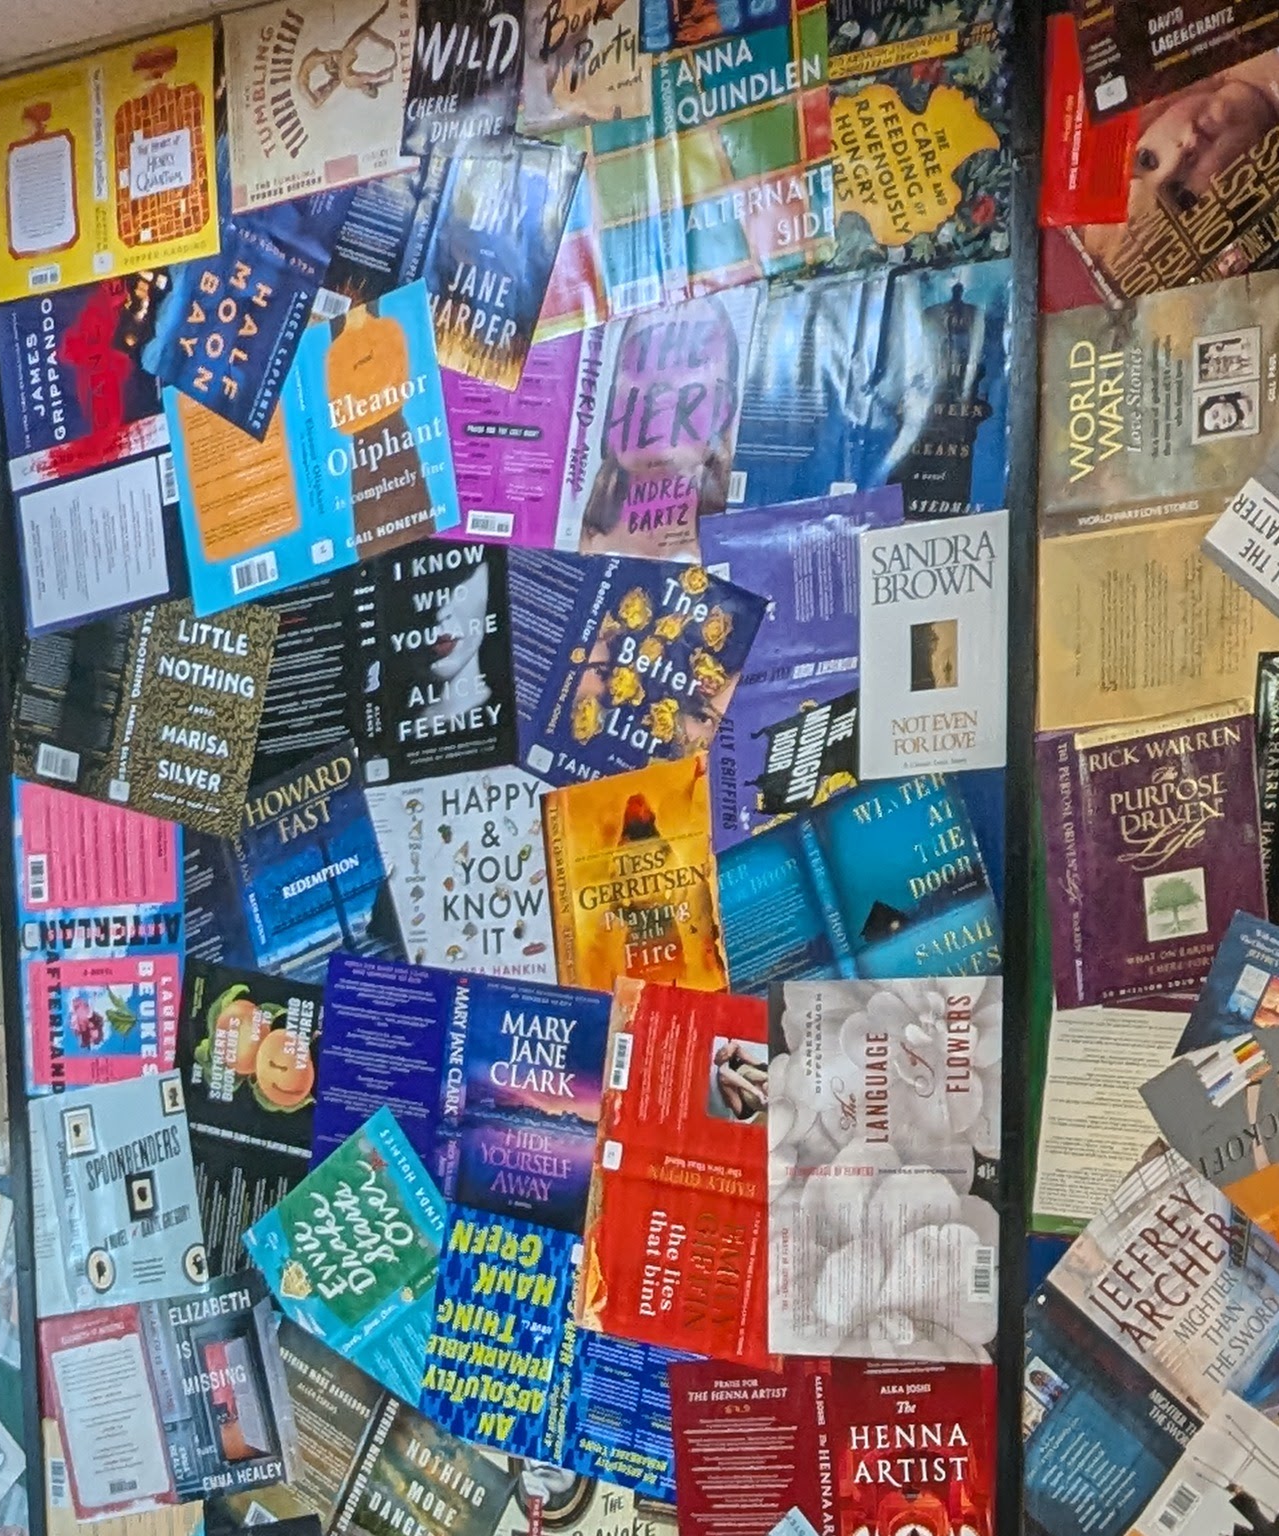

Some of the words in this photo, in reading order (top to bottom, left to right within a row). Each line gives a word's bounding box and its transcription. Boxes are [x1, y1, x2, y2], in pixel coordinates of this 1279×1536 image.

[419, 13, 518, 82] WILD
[676, 40, 752, 85] ANNA
[407, 95, 457, 121] CHERIE
[676, 56, 819, 125] QUINDLEN
[431, 116, 502, 143] DIMALINE
[911, 122, 938, 175] CARE
[836, 114, 876, 206] HUNGRY
[858, 99, 912, 236] RAVENOUSLY
[880, 101, 918, 198] FEEDING
[450, 263, 509, 307] JANE
[25, 334, 48, 417] JAMES
[43, 299, 67, 440] GRIPPANDO
[326, 373, 428, 429] Eleanor
[328, 419, 443, 477] Oliphant
[346, 529, 373, 548] GAIL
[377, 504, 447, 541] HONEYMAN
[628, 503, 689, 534] BARTZ
[394, 563, 401, 580] I
[411, 545, 486, 577] KNOW
[872, 531, 996, 576] SANDRA
[413, 584, 467, 609] WHO
[662, 579, 707, 624] The
[872, 562, 995, 604] BROWN
[178, 619, 249, 656] LITTLE
[392, 629, 438, 651] YOU
[452, 615, 499, 637] ARE
[157, 656, 256, 698] NOTHING
[617, 636, 702, 698] Better
[409, 676, 488, 705] ALICE
[161, 724, 229, 757] MARISA
[399, 706, 502, 741] FEENEY
[607, 708, 664, 753] Liar
[891, 719, 925, 734] NOT
[934, 711, 979, 731] EVEN
[893, 739, 926, 754] FOR
[929, 731, 977, 751] LOVE
[1089, 747, 1139, 772] RICK
[1146, 727, 1241, 758] WARREN
[157, 760, 221, 792] SILVER
[246, 757, 352, 824] HOWARD
[441, 782, 540, 816] HAPPY
[277, 801, 332, 843] FAST
[482, 823, 501, 845] &
[281, 853, 360, 899] REDEMPTION
[462, 855, 523, 884] YOU
[615, 852, 665, 876] TESS
[443, 889, 544, 920] KNOW
[578, 863, 707, 911] GERRITSEN
[604, 904, 691, 931] Playing
[483, 928, 503, 955] IT
[624, 940, 677, 968] Fire
[502, 1010, 576, 1043] MARY
[947, 995, 971, 1093] FLOWERS
[511, 1037, 566, 1069] JANE
[490, 1062, 575, 1098] CLARK
[865, 1032, 889, 1142] LANGUAGE
[86, 1129, 180, 1190] SPOONBENDERS
[481, 1147, 572, 1183] YOURSELF
[490, 1168, 551, 1202] AWAY
[451, 1221, 544, 1262] GREEN
[1089, 1182, 1205, 1335] JEFFREY
[472, 1265, 556, 1305] HANK
[1121, 1213, 1244, 1353] ARCHER
[169, 1291, 251, 1326] ELIZABETH
[177, 1340, 192, 1360] IS
[183, 1365, 246, 1396] MISSING
[880, 1384, 904, 1394] ALKA
[906, 1383, 931, 1393] JOSHI
[897, 1400, 917, 1415] The
[850, 1424, 967, 1450] HENNA
[406, 1439, 486, 1507] NOTHING
[854, 1458, 967, 1485] ARTIST
[408, 1483, 455, 1528] MORE
